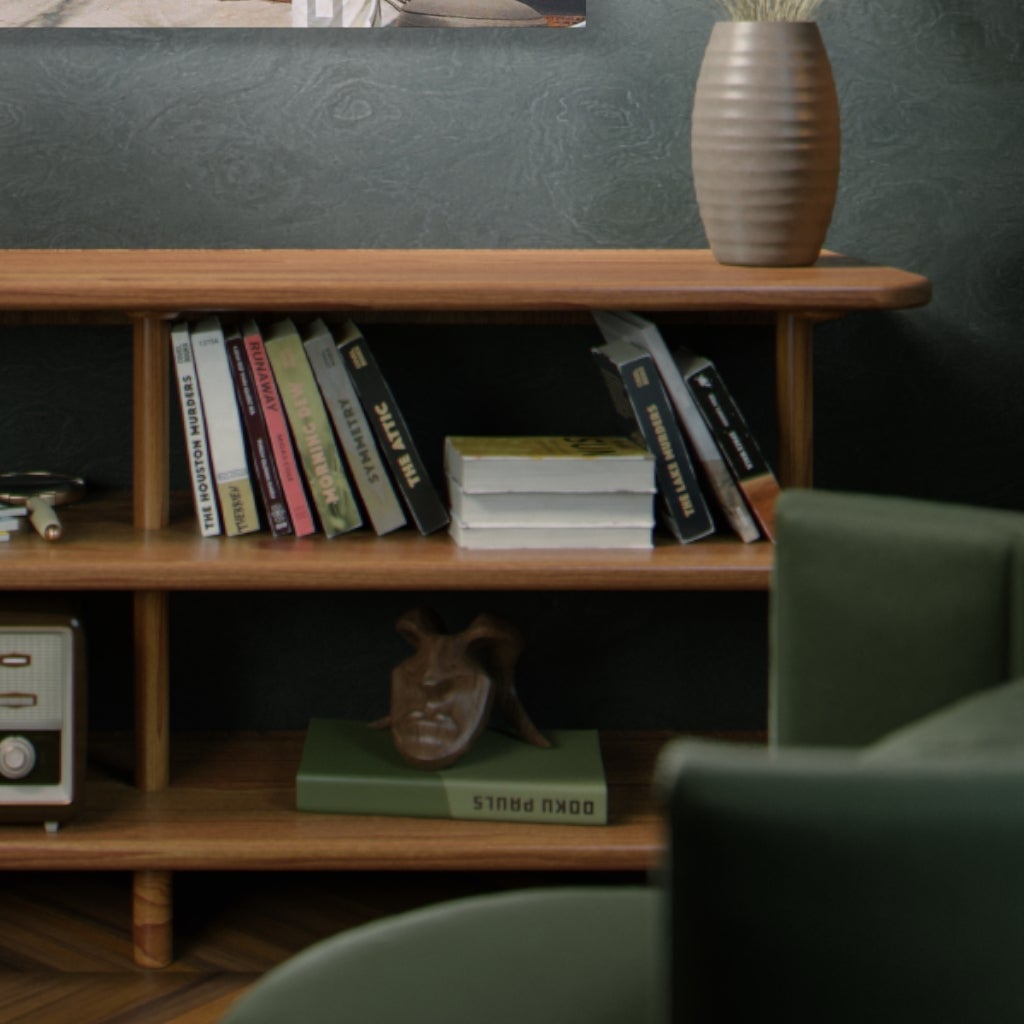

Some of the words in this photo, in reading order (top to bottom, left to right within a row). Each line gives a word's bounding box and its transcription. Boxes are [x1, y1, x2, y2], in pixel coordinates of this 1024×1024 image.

[250, 341, 278, 412] RUNAWAY
[288, 381, 312, 418] DEW
[182, 375, 201, 436] MURDERS
[374, 400, 407, 452] ATTIC
[646, 403, 676, 460] MURDERS
[303, 421, 340, 505] MORNING
[338, 397, 380, 484] SYMMETRY
[192, 439, 210, 503] HOUSTON
[397, 453, 422, 489] THE
[202, 506, 215, 530] THE
[677, 492, 696, 519] THE
[473, 795, 535, 813] PAULS
[542, 798, 595, 815] DOKU
